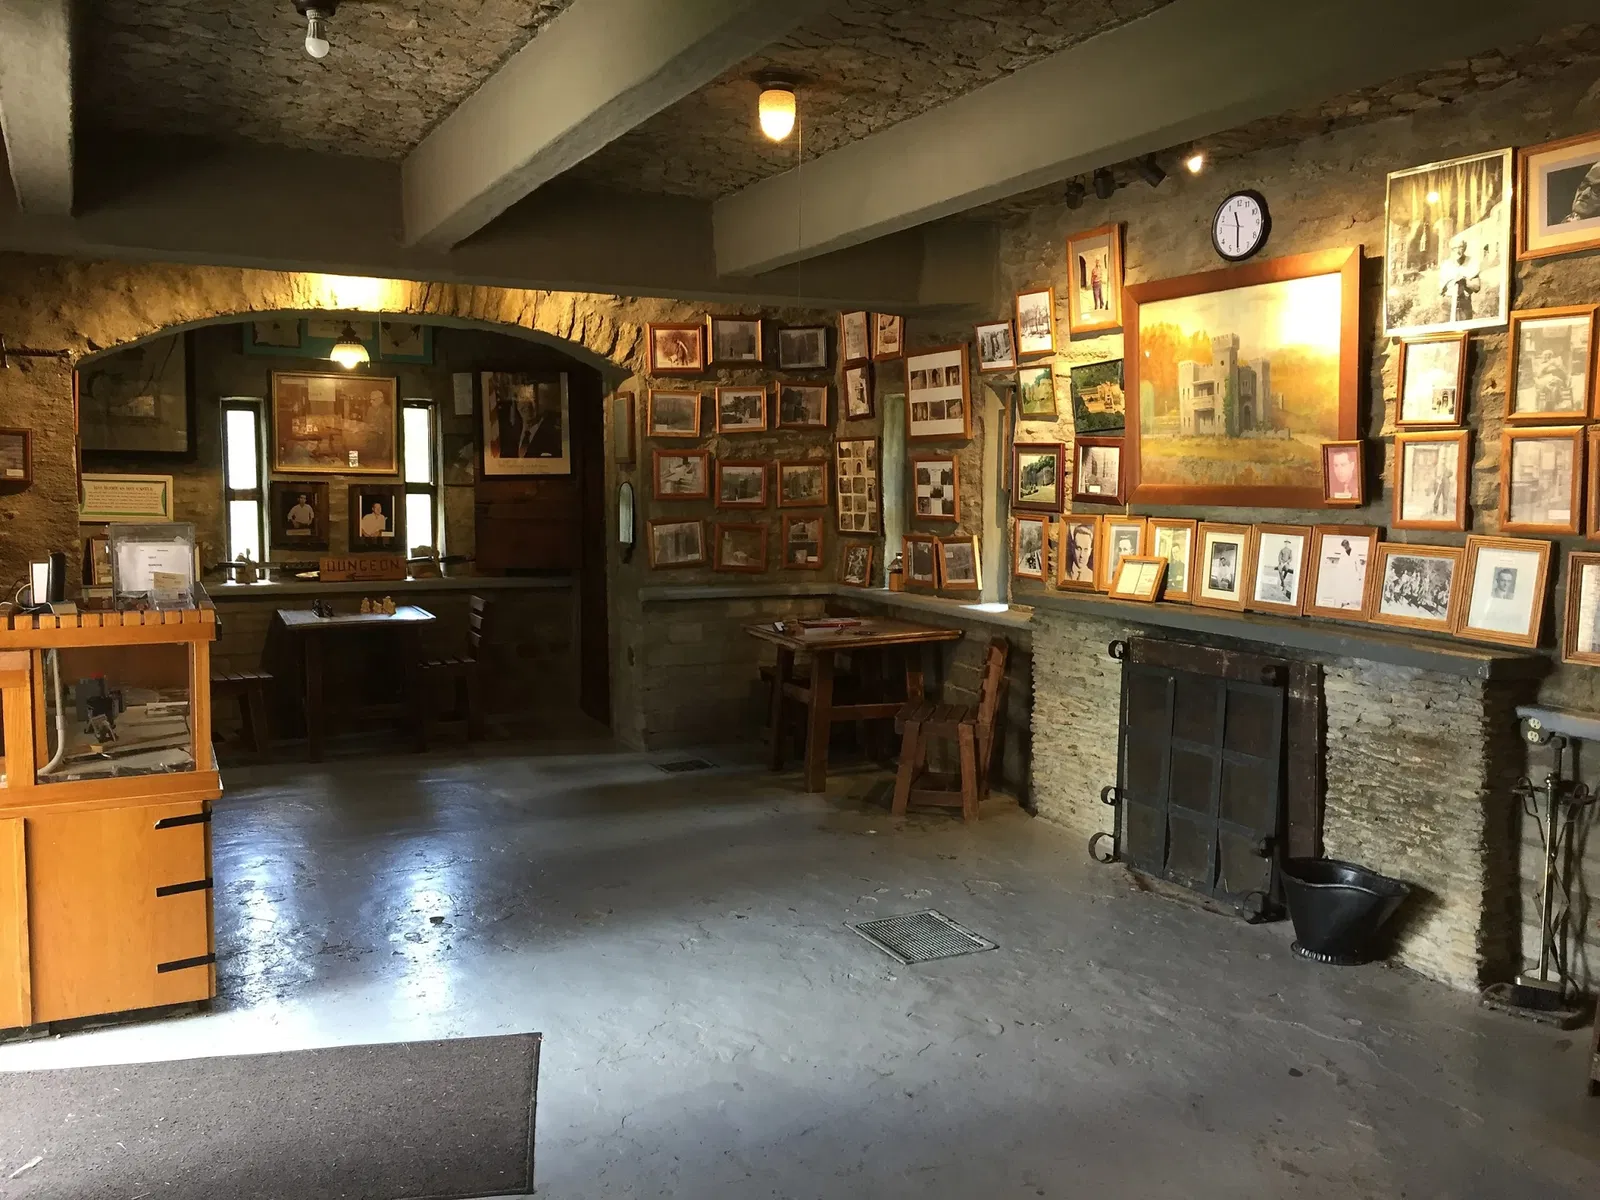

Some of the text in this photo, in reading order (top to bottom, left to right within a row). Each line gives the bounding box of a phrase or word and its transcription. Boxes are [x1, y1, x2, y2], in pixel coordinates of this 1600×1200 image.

[1237, 199, 1243, 207] 12
[1252, 208, 1258, 216] 10
[1221, 215, 1225, 223] 2
[1219, 227, 1223, 235] 3
[1252, 231, 1257, 239] 8
[1228, 244, 1232, 252] 5
[1246, 241, 1250, 249] 7
[327, 559, 401, 572] DUNGEON
